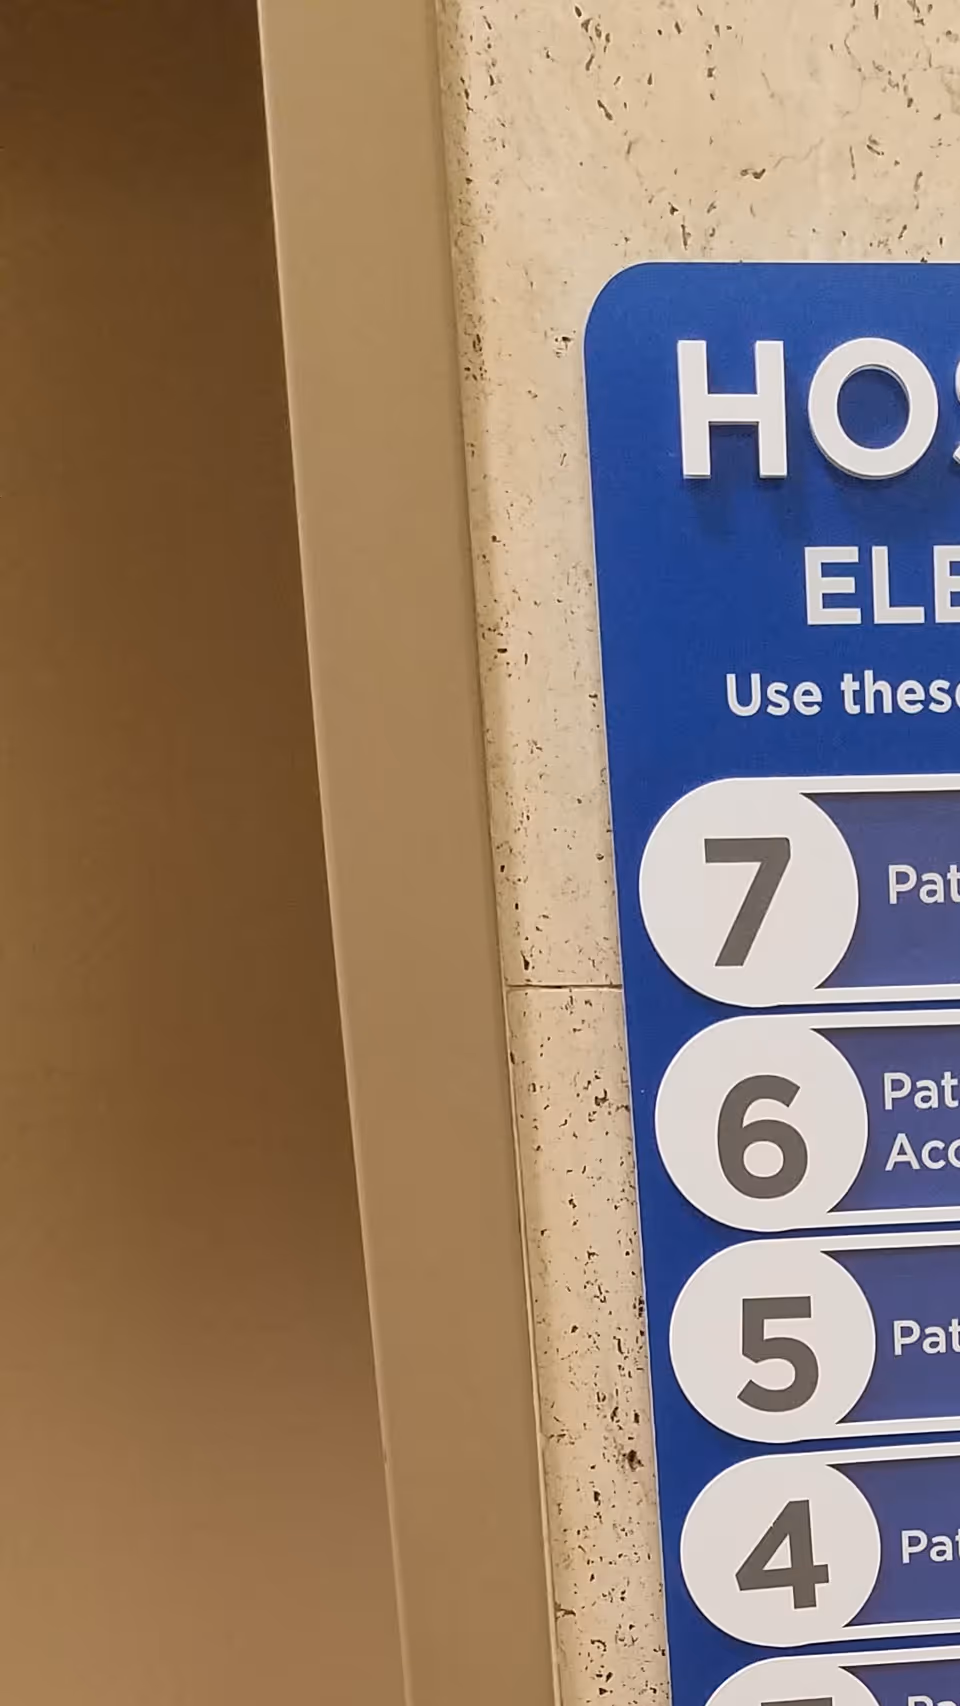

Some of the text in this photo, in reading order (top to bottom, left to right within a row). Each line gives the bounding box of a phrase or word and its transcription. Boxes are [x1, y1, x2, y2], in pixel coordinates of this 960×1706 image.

[727, 674, 822, 716] Use
[704, 837, 791, 966] 7
[717, 1075, 808, 1199] 6
[737, 1296, 818, 1412] 5
[735, 1500, 829, 1609] 4
